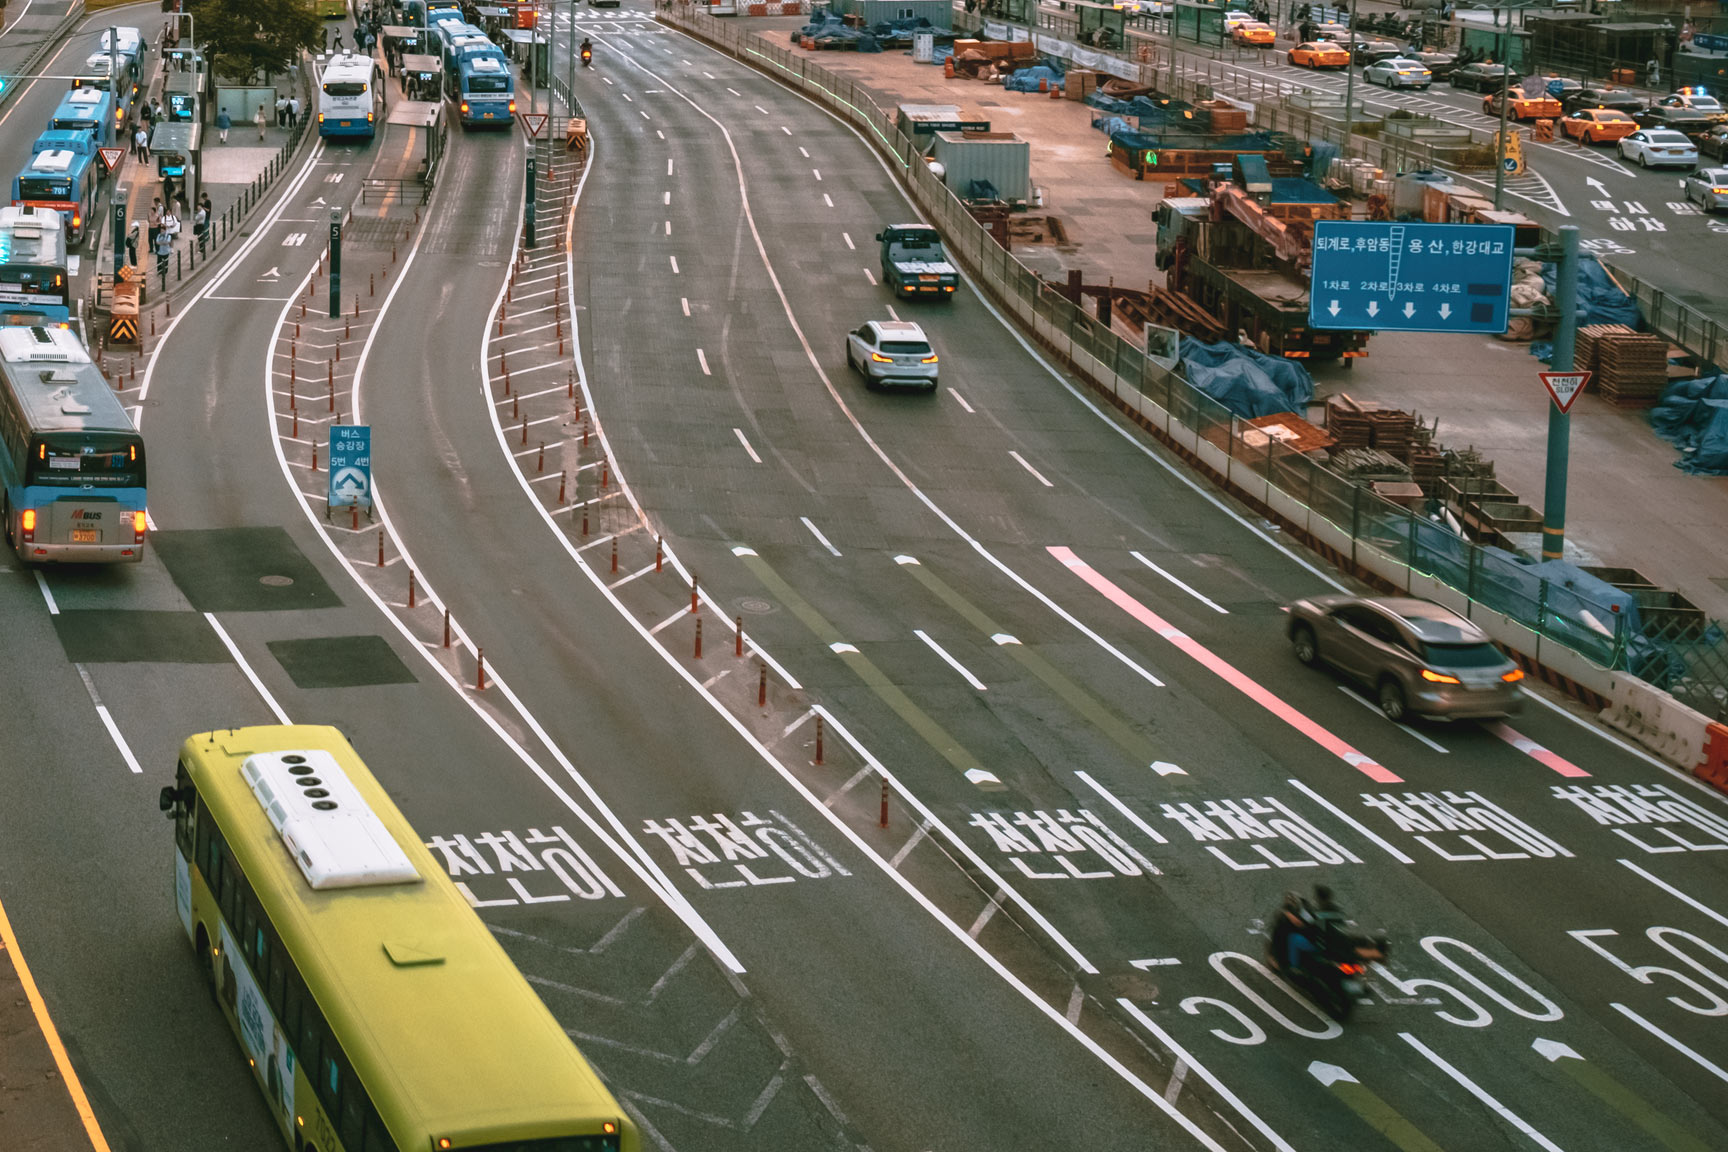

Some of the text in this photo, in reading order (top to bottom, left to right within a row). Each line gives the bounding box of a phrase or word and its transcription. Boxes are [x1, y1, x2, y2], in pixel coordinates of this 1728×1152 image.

[527, 161, 534, 170] 4
[53, 186, 66, 195] 701
[116, 208, 124, 218] 6
[332, 226, 339, 237] 5
[1323, 280, 1461, 294] 1차로 2차로 3차로 4차로
[341, 429, 360, 438] 버스
[336, 441, 365, 451] 승강장
[331, 456, 369, 467] 5번 4번
[1359, 790, 1576, 863] 천천히
[1160, 796, 1365, 871] 천천히
[643, 809, 853, 890] 천천히
